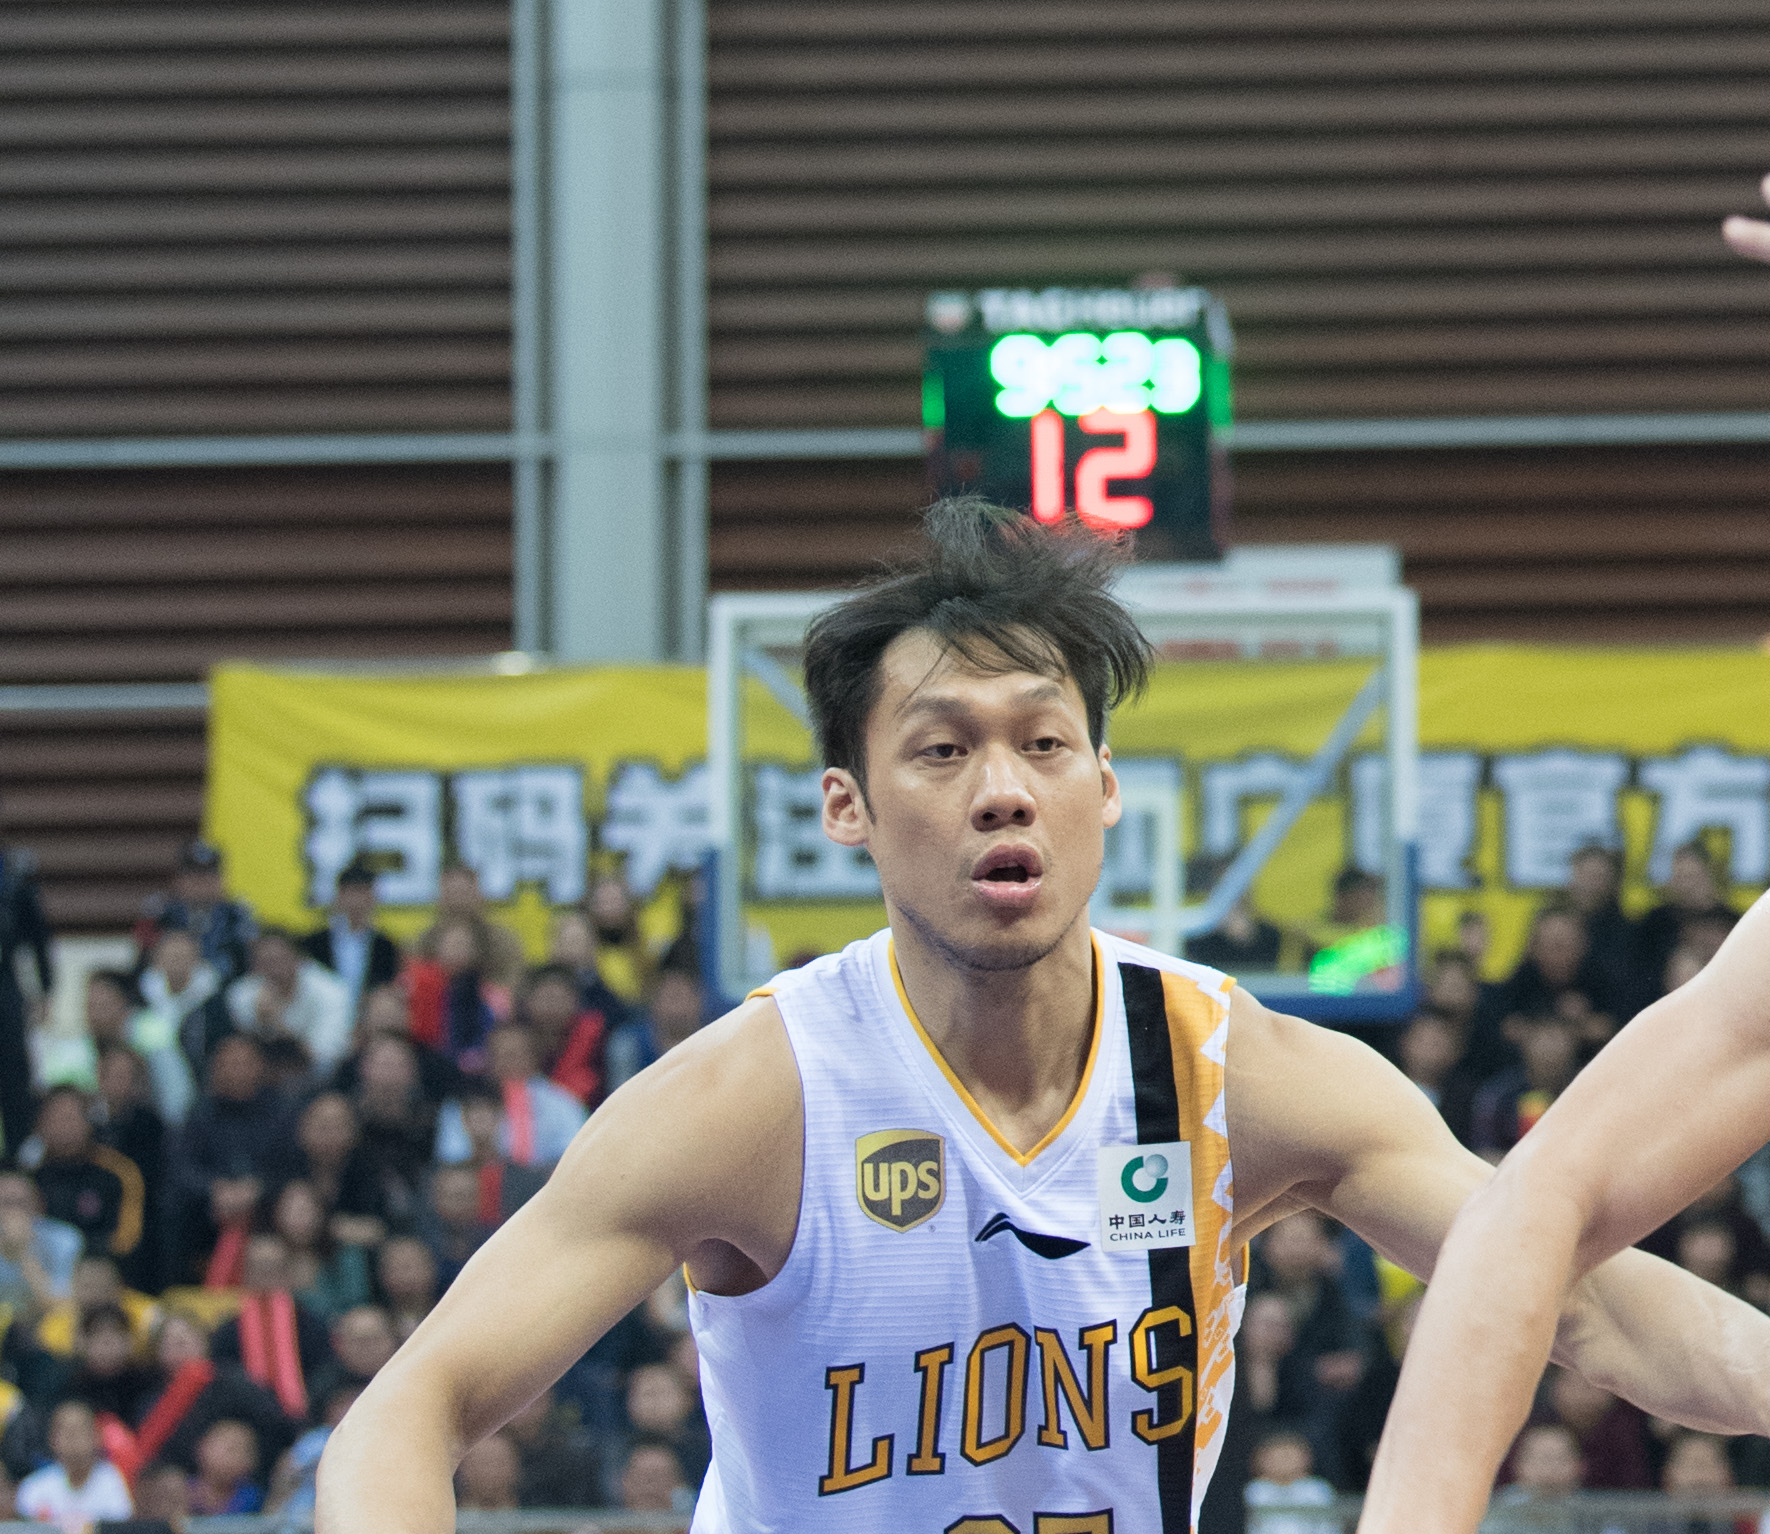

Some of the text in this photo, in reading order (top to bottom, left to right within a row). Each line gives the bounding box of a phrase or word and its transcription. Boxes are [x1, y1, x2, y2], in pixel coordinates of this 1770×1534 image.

[1031, 407, 1157, 528] 12
[1109, 1208, 1186, 1230] 中国人寿
[1110, 1227, 1187, 1242] CHINA LIFE
[818, 1305, 1198, 1497] LIONS
